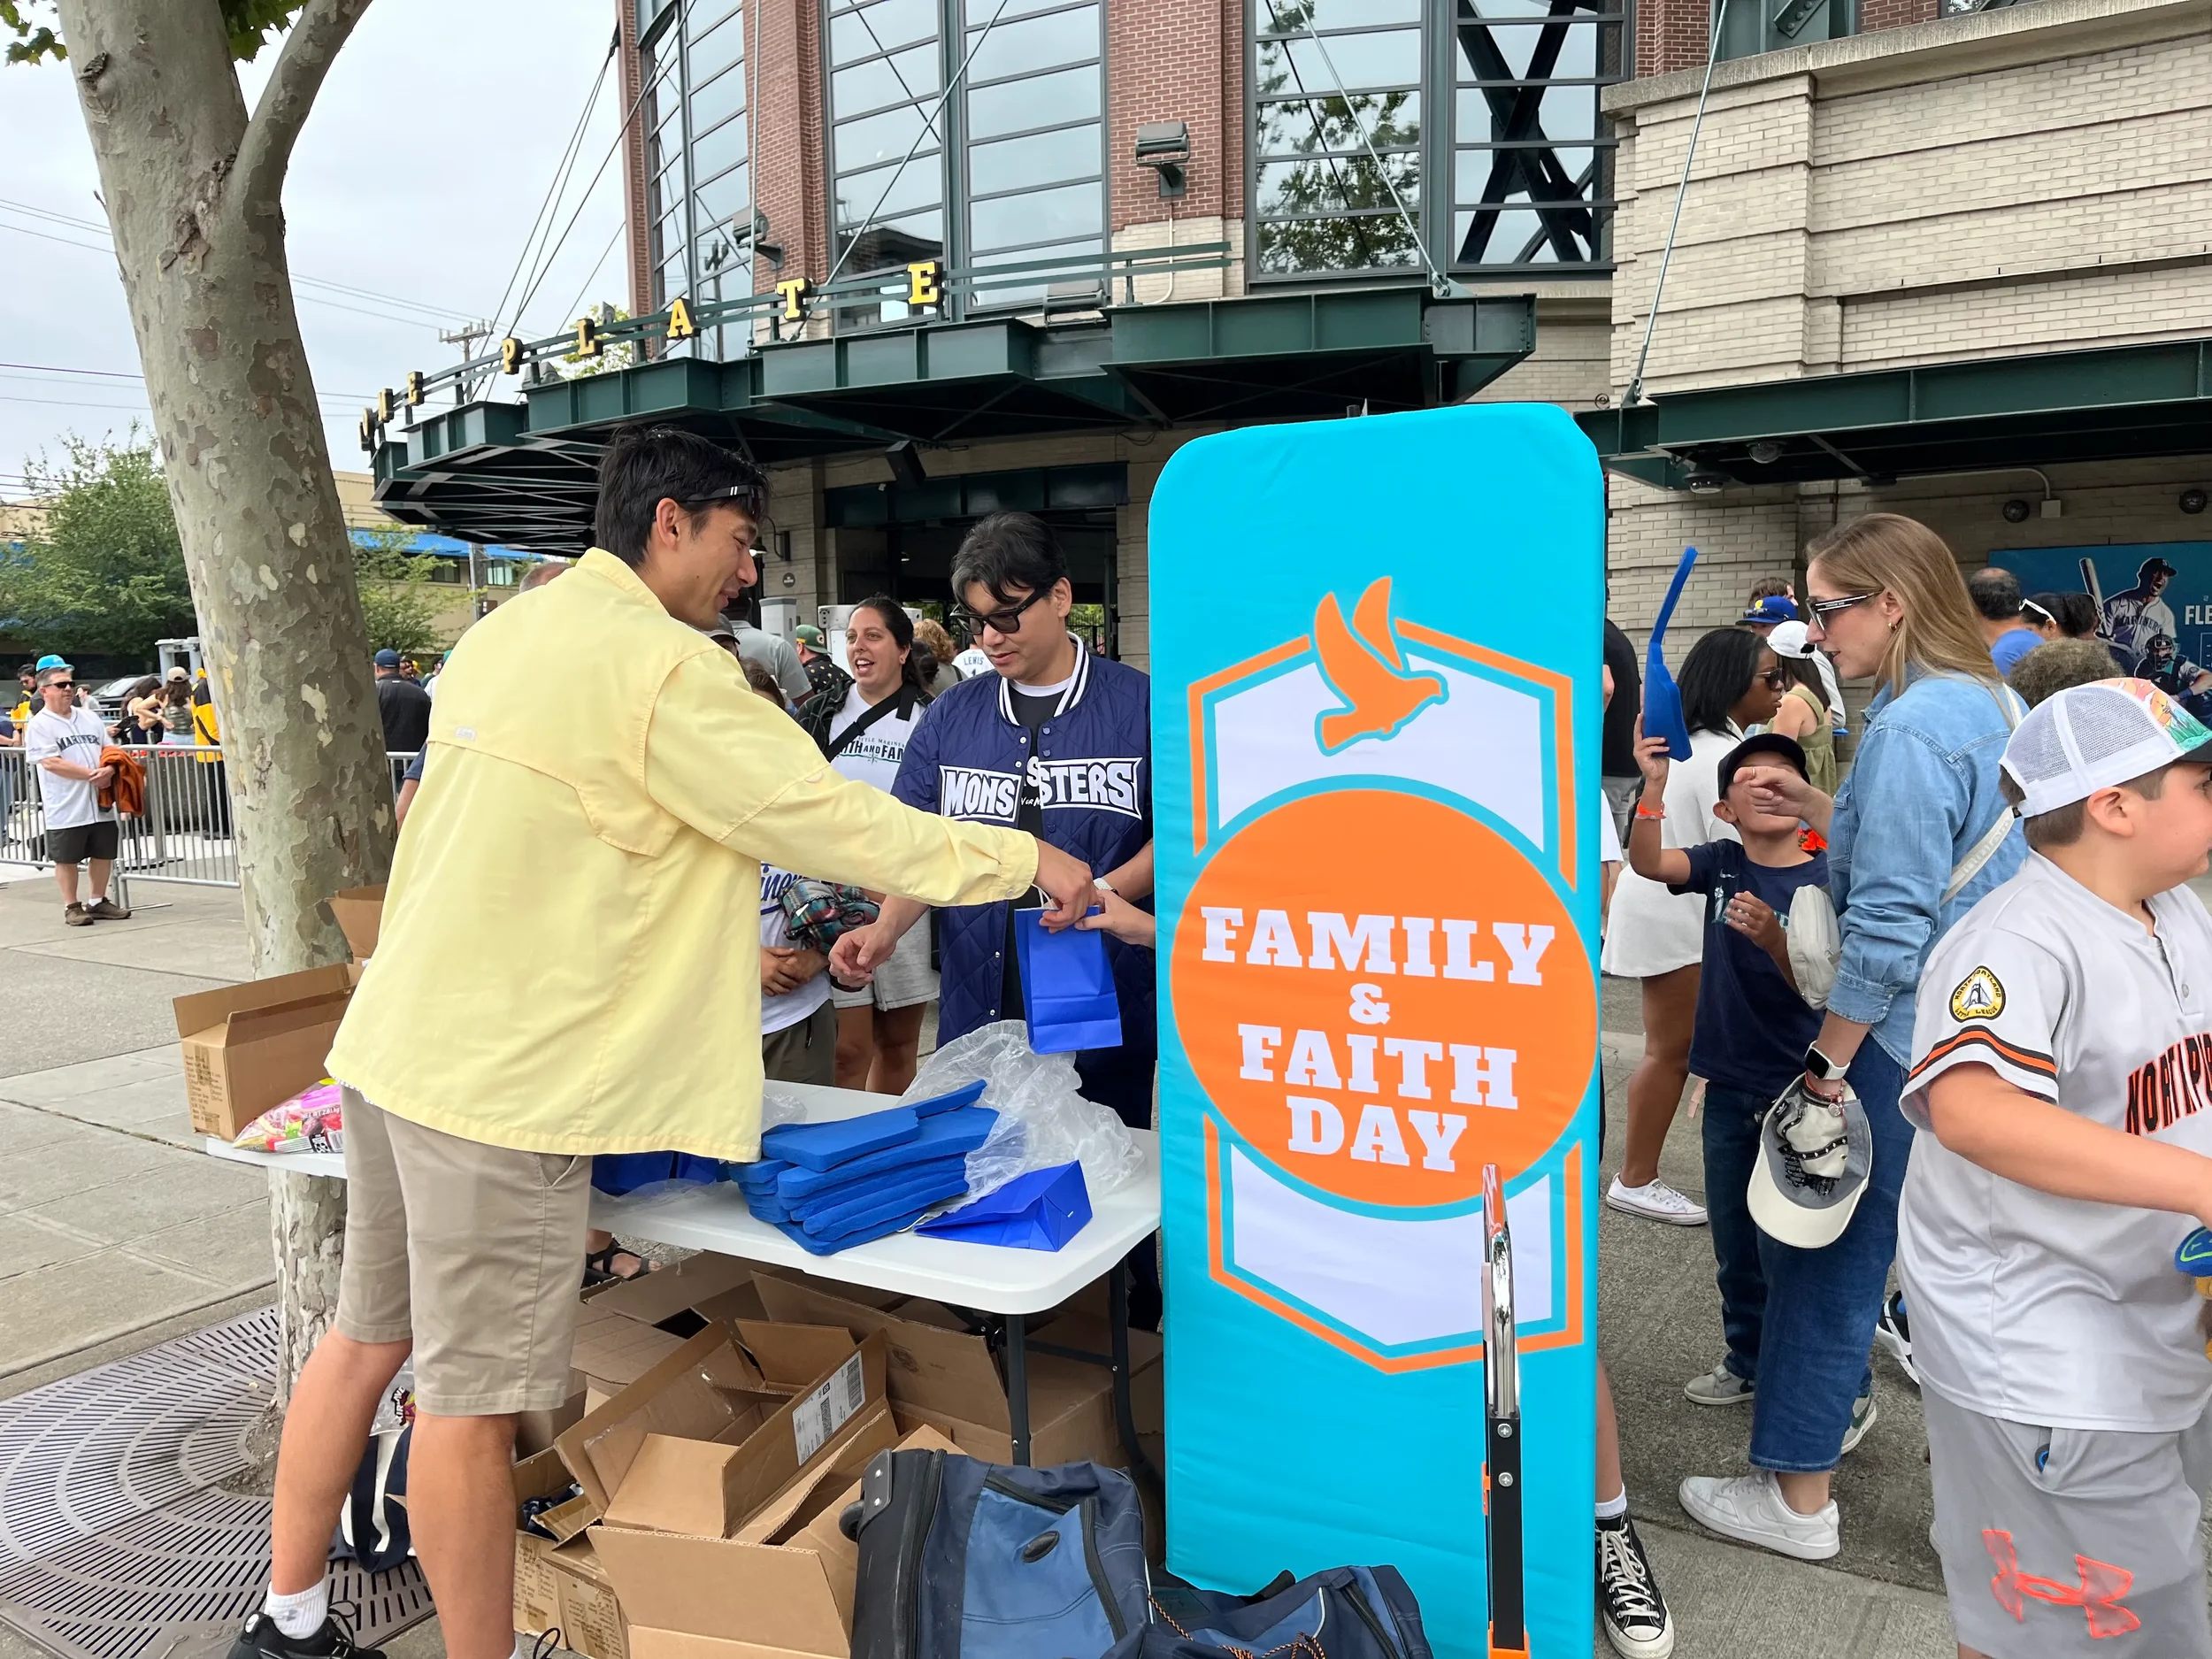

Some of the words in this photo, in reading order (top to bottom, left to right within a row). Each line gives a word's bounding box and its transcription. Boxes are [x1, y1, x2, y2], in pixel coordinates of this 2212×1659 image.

[502, 261, 938, 374] PLATE
[963, 657, 984, 665] LEWIS
[56, 734, 100, 751] MARINER
[864, 745, 880, 754] AND
[1201, 906, 1555, 986] FAMILY
[1348, 983, 1390, 1025] &
[1955, 978, 1972, 1000] NORTH
[1238, 1024, 1518, 1110] FAITH
[1286, 1095, 1467, 1172] DAY
